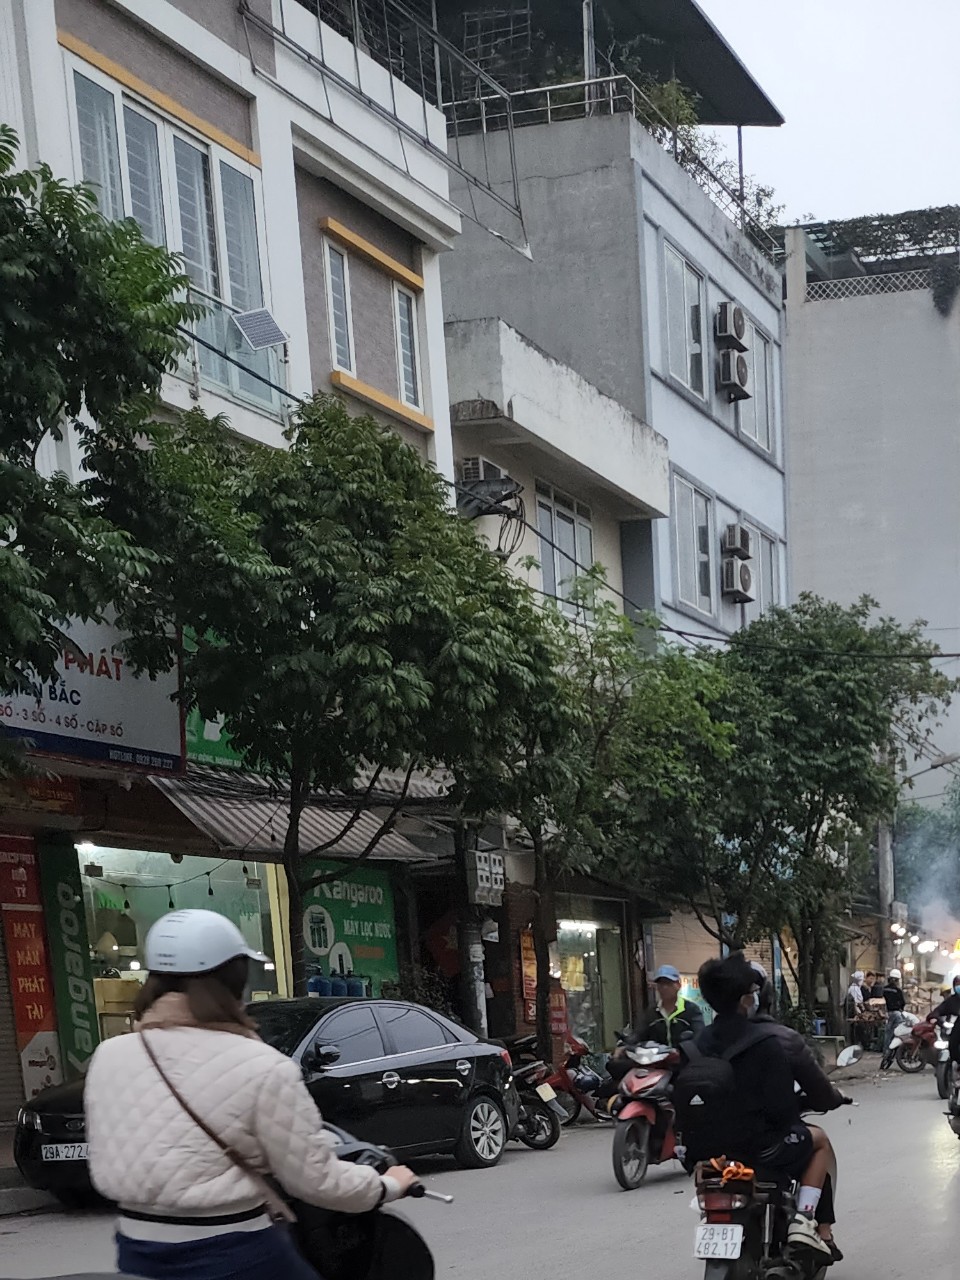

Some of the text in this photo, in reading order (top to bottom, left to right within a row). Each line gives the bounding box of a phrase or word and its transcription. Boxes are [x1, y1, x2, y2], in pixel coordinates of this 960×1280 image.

[64, 648, 123, 681] PHÁT
[49, 680, 81, 705] BẮC
[55, 715, 61, 726] 4
[64, 713, 78, 729] SỐ
[110, 722, 123, 737] SỐ
